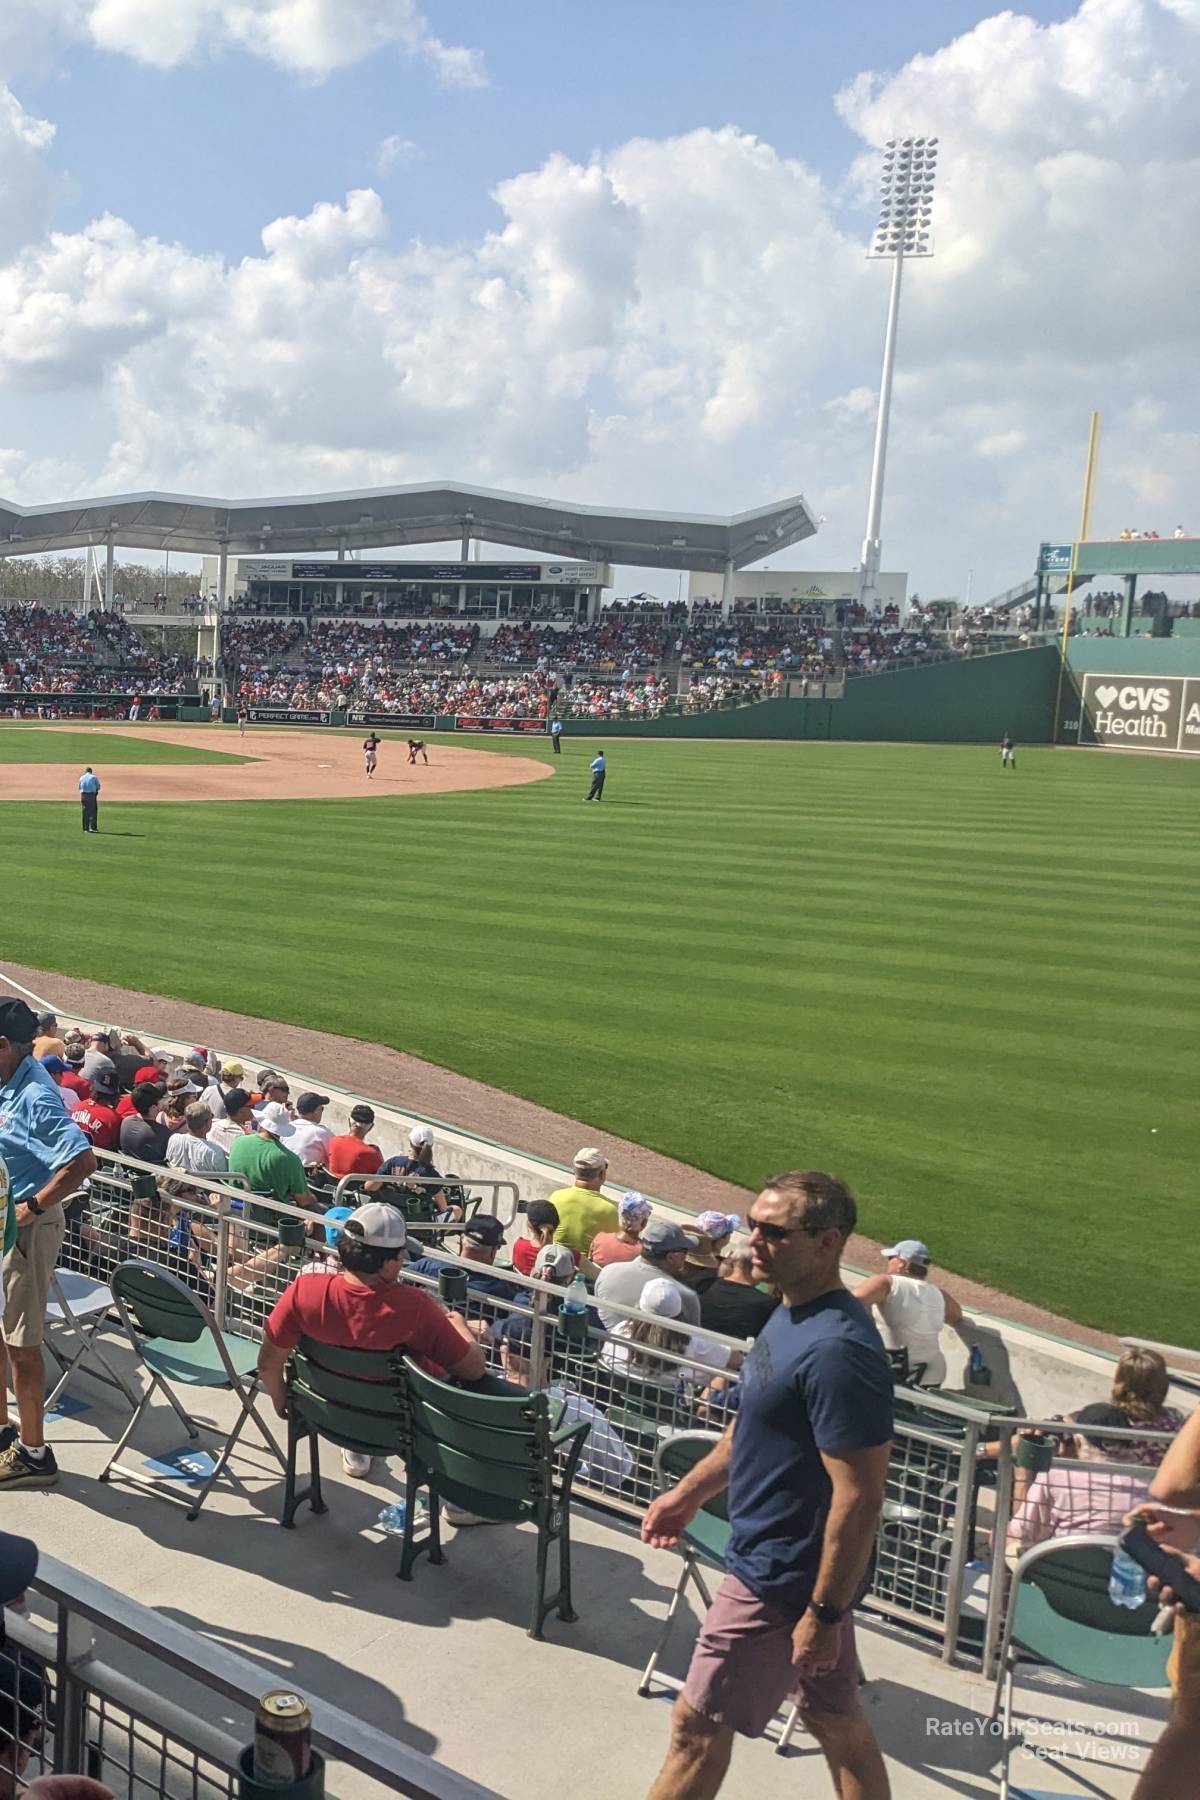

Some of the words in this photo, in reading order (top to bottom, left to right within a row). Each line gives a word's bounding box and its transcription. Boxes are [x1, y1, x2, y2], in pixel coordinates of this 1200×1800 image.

[1118, 686, 1171, 712] CVS
[258, 712, 288, 720] PERFECT
[1094, 711, 1167, 738] Health
